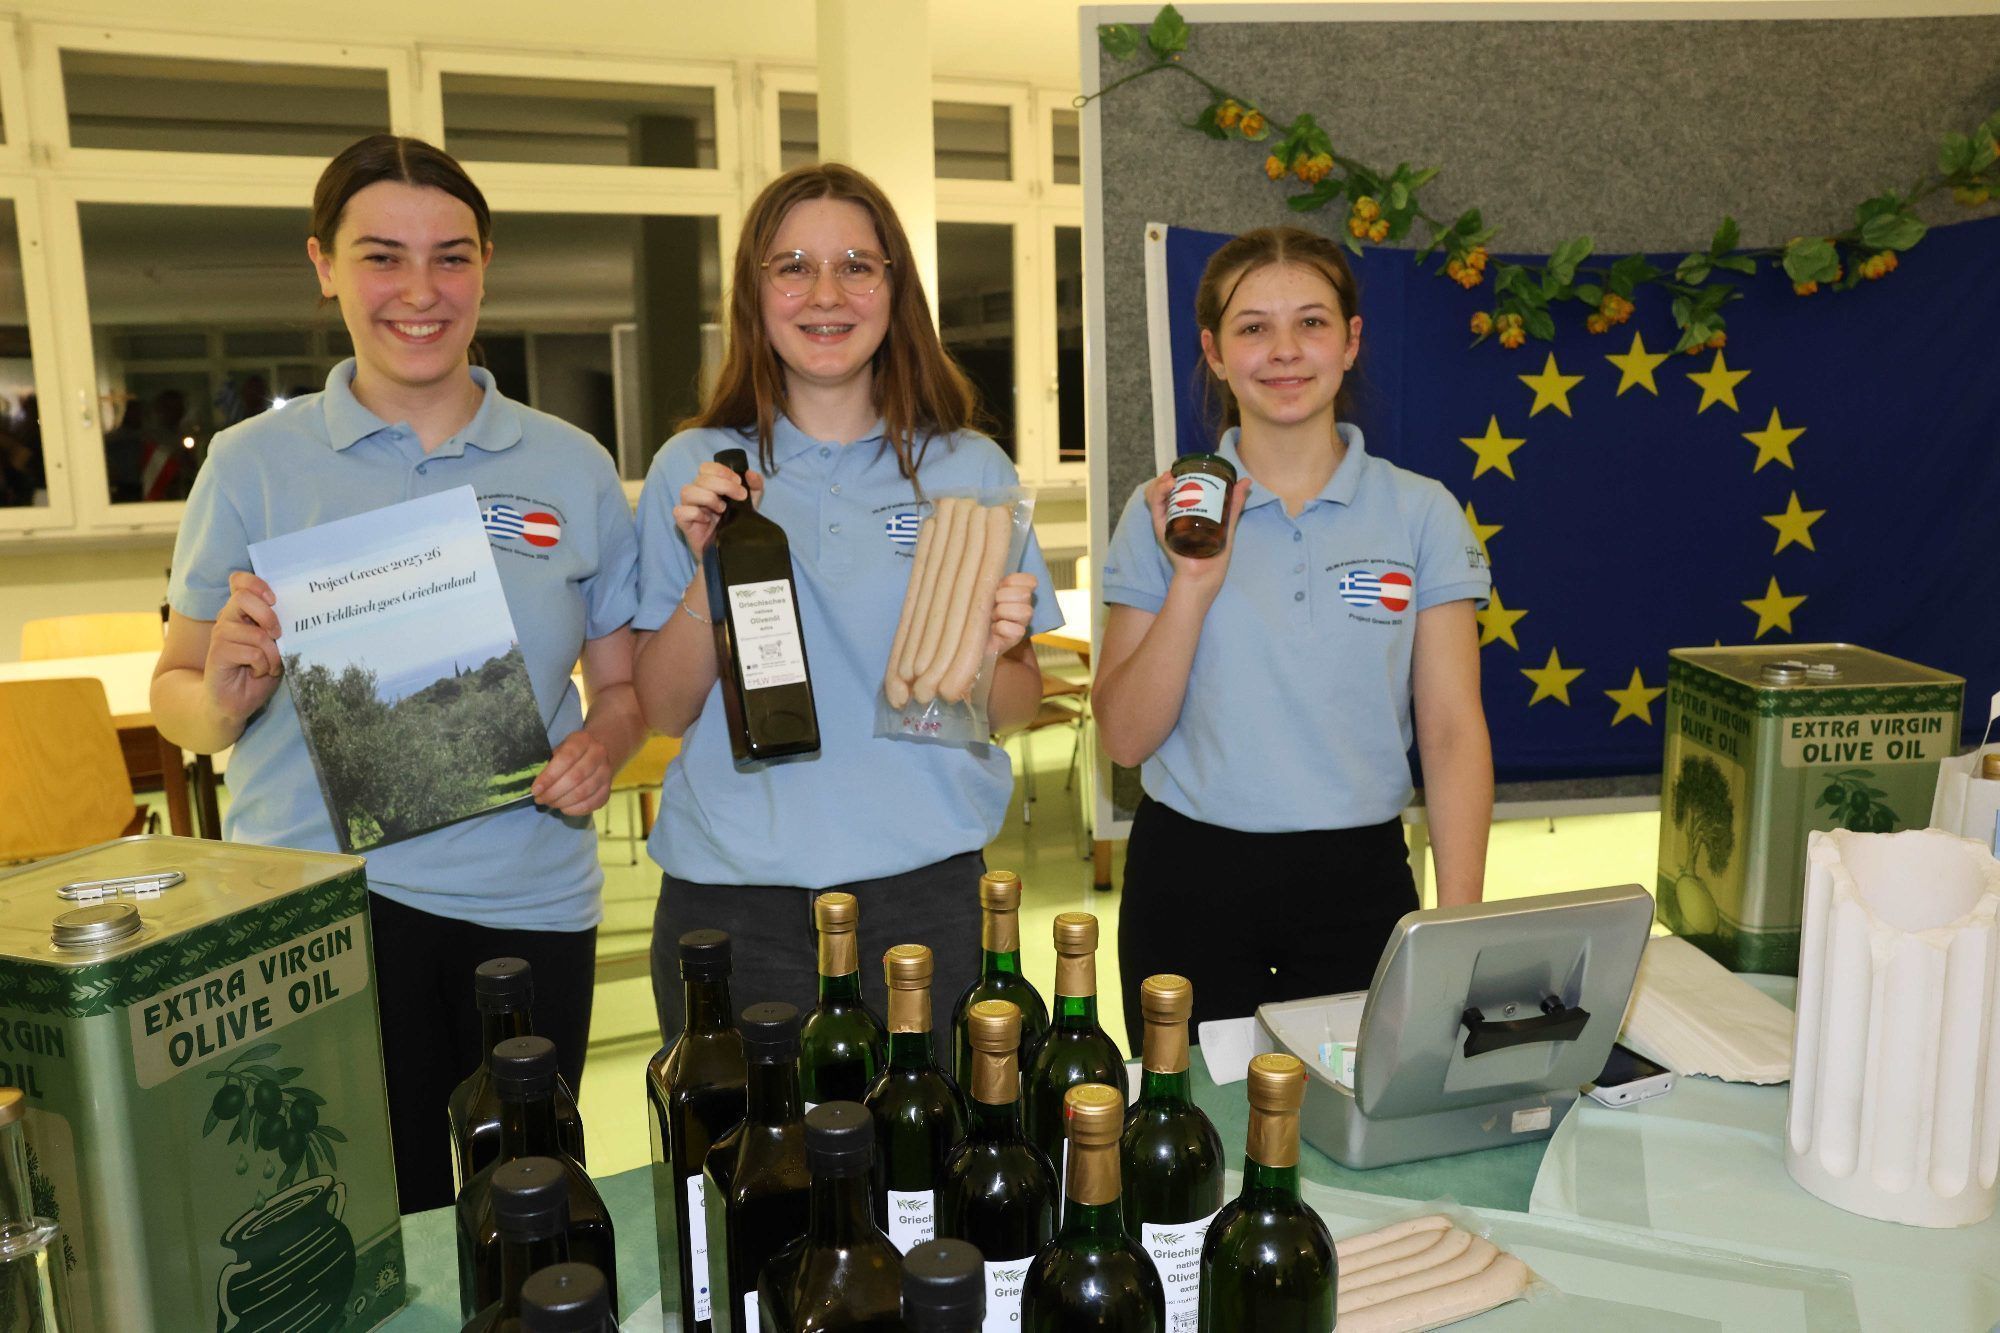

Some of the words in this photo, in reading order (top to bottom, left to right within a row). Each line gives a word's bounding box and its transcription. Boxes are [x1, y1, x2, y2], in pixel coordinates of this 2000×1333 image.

[308, 575, 350, 593] Project
[350, 565, 389, 581] Greece
[295, 614, 325, 632] HLW
[326, 599, 376, 624] Feldkirch
[377, 594, 401, 612] goes
[402, 571, 476, 602] Griechenland
[1672, 687, 1706, 717] EXTRA
[1712, 703, 1750, 737] VIRGIN
[1791, 719, 1860, 739] EXTRA
[1870, 717, 1942, 736] VIRGIN
[1681, 715, 1713, 745] OLIVE
[1719, 733, 1738, 757] OIL
[1802, 742, 1874, 763] OLIVE
[1886, 740, 1925, 760] OIL
[144, 969, 246, 1036] EXTRA
[258, 926, 353, 984] VIRGIN
[168, 996, 273, 1067] OLIVE
[288, 969, 340, 1014] OIL
[1153, 1247, 1202, 1259] Griechis
[1180, 1284, 1199, 1293] extra
